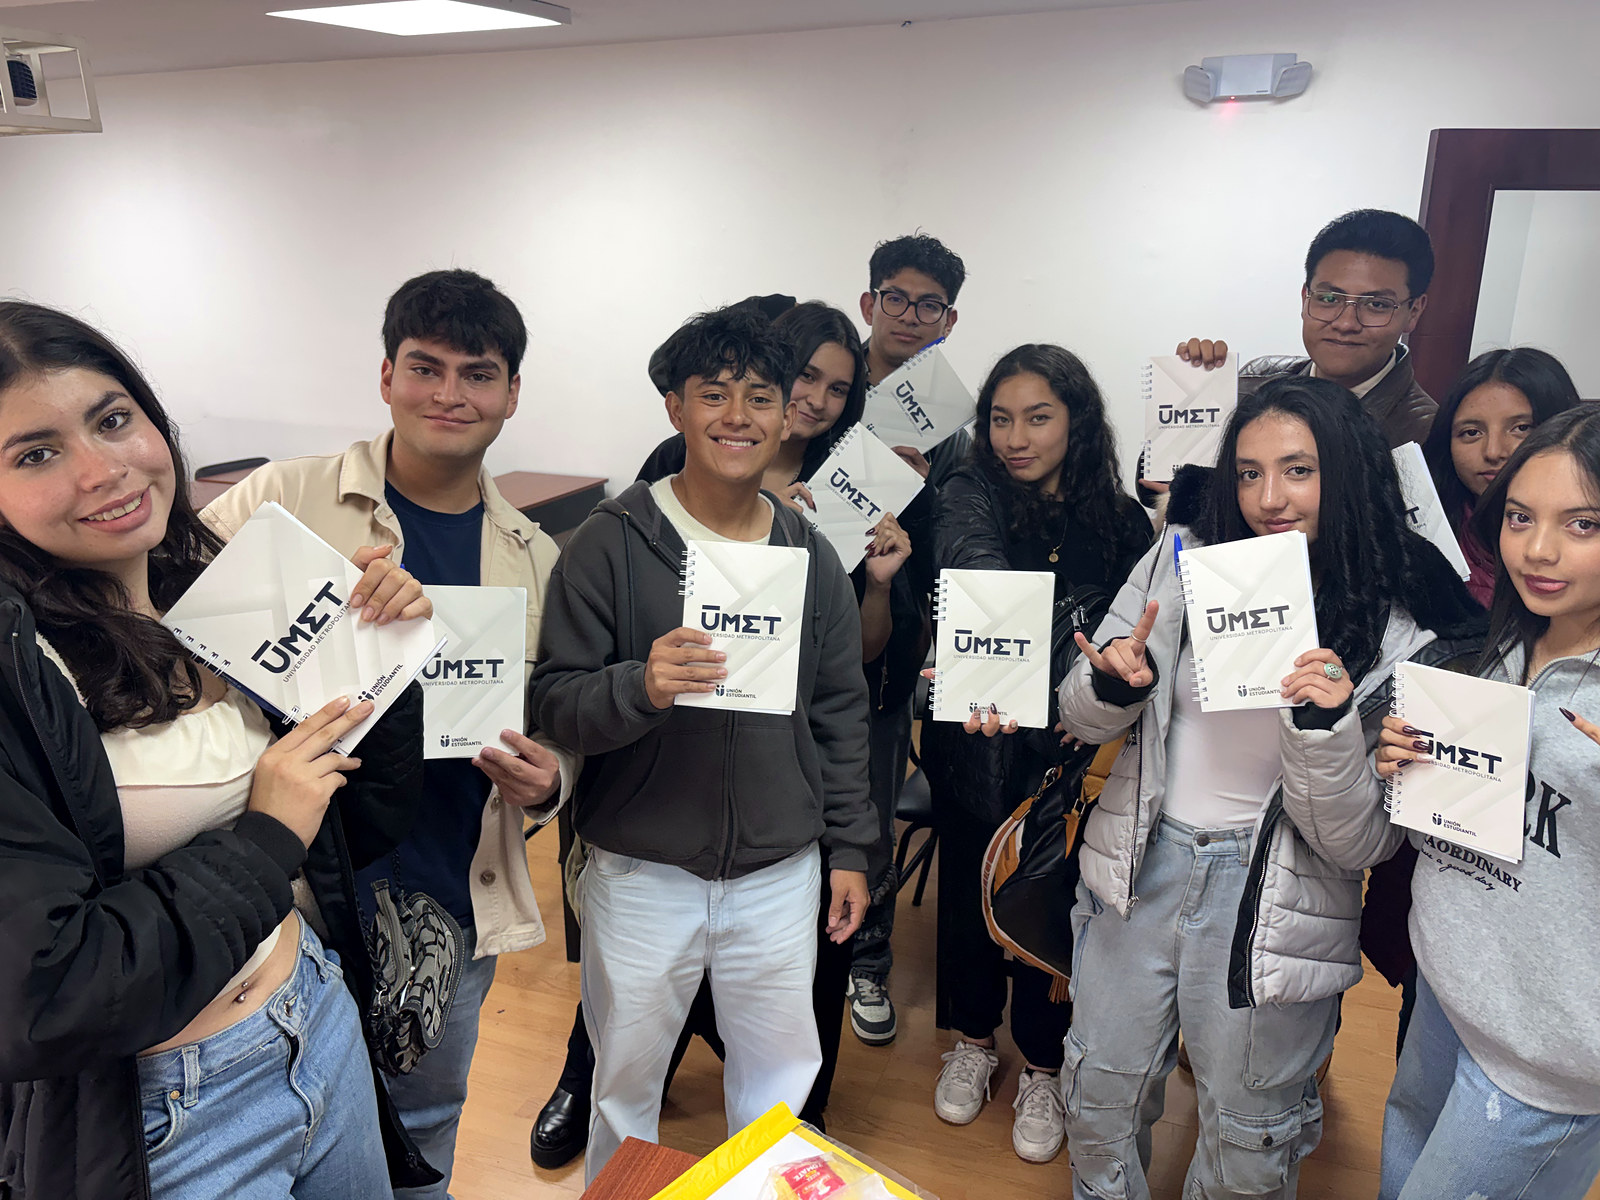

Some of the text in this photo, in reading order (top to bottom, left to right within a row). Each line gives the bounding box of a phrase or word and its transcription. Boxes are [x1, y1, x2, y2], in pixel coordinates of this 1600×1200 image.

[1246, 626, 1293, 636] METROPOLITANA
[283, 600, 351, 683] UNIVERSIDAD METROPOLITAN
[370, 675, 386, 693] UNIÓN
[375, 664, 404, 696] ESTUDIANTIL
[1452, 766, 1502, 782] METROPOLITANA
[1443, 824, 1477, 837] ESTUDIANTIL
